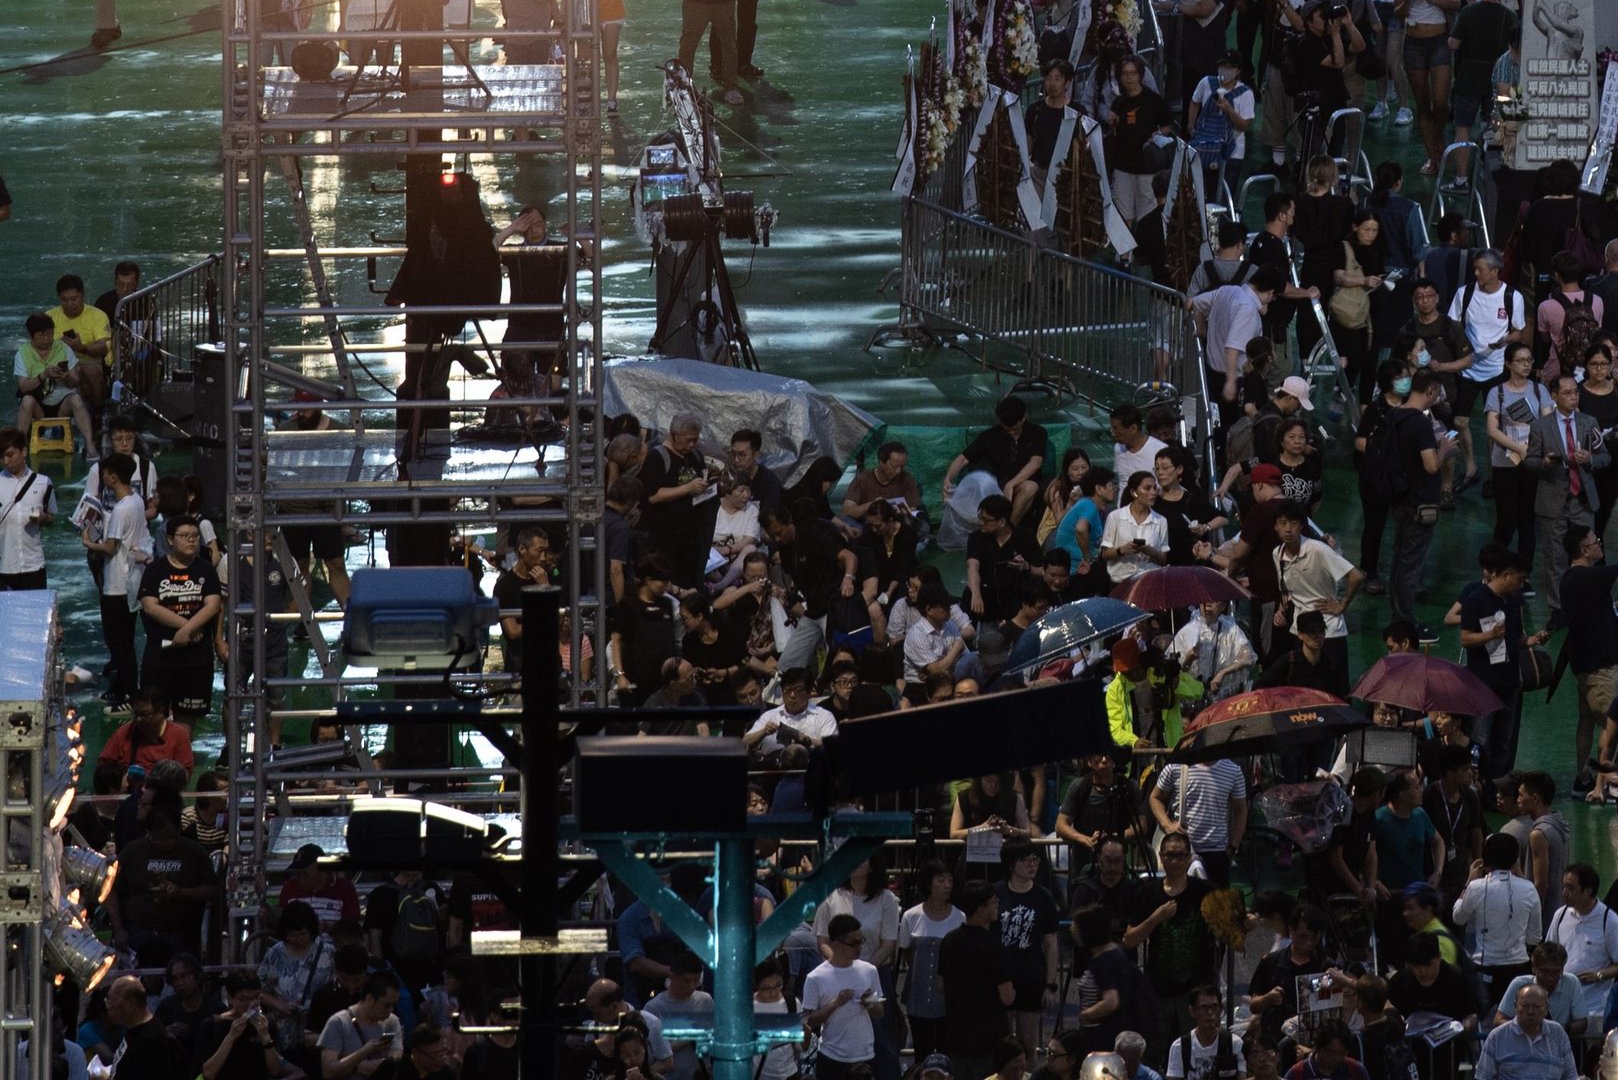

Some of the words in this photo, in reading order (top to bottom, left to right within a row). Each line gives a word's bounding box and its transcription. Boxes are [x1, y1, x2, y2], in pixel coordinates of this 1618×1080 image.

[1527, 59, 1590, 75] 釋放民運人士
[1527, 81, 1590, 96] 平反八九民運
[1526, 124, 1589, 139] 結束一黨專政
[1526, 145, 1588, 161] 建設民主中國
[147, 860, 182, 871] BRAVERY
